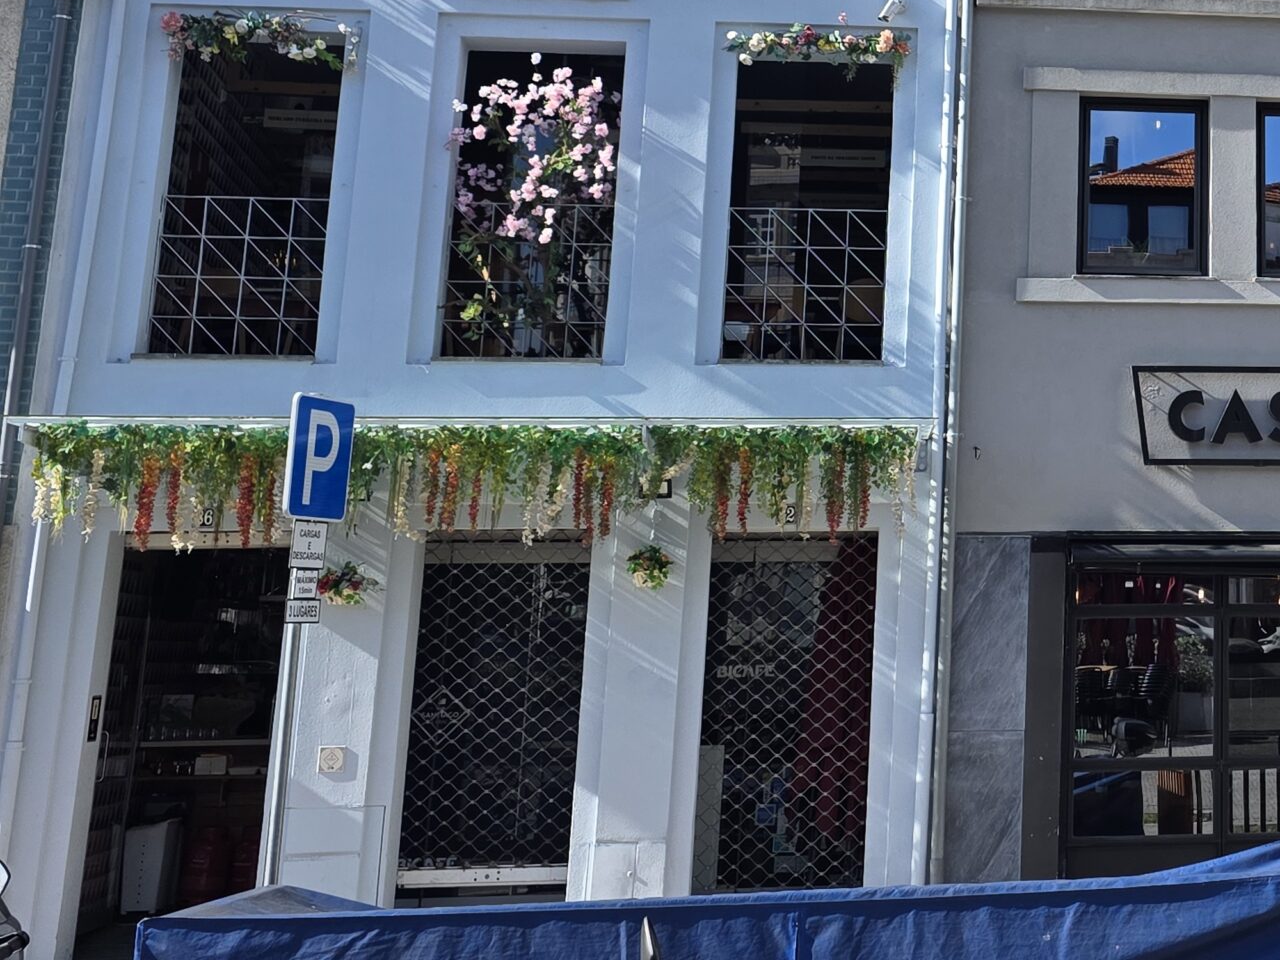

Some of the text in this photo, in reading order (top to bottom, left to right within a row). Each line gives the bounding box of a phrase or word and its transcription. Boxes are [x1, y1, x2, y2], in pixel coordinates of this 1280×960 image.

[302, 408, 341, 506] P
[300, 528, 321, 539] CARGAS
[307, 541, 312, 550] E
[292, 550, 324, 561] DESCARGAS
[293, 605, 318, 618] LUGARES
